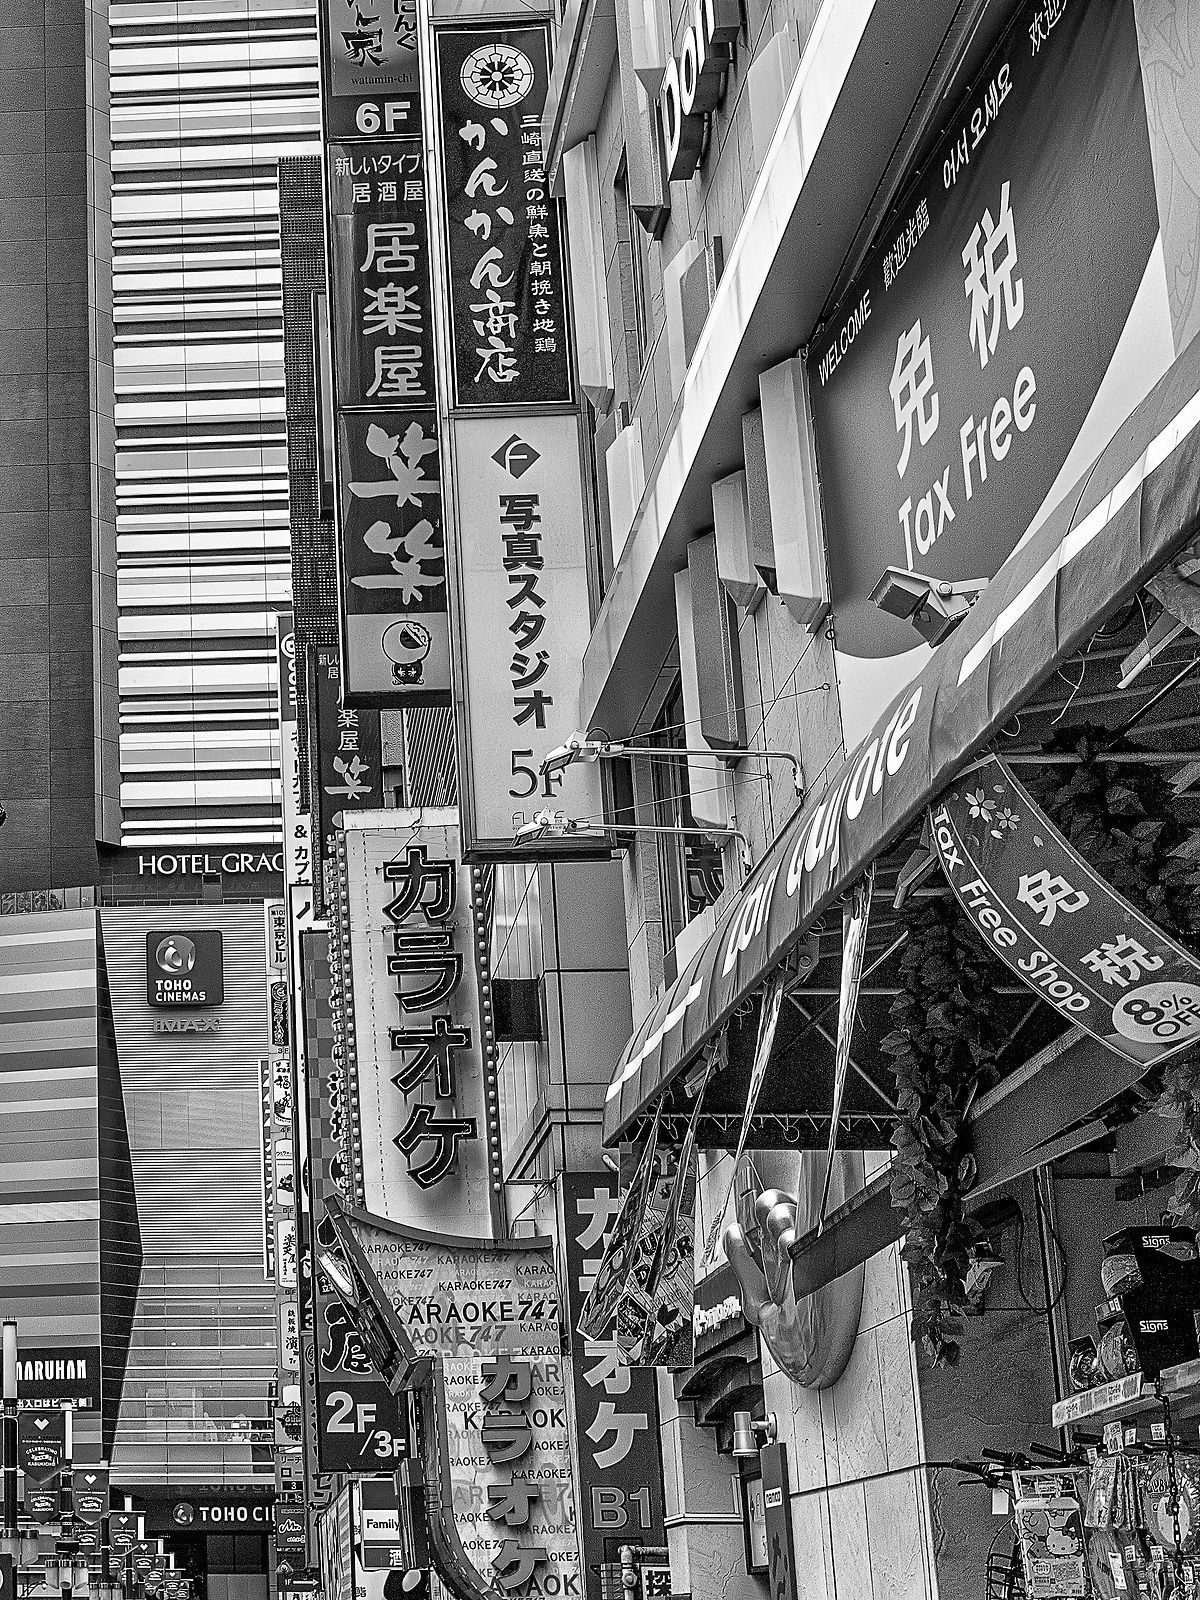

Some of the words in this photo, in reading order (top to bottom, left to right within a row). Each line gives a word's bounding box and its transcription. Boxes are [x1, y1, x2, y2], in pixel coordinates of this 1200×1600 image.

[351, 73, 413, 86] watamin-chi
[356, 101, 411, 133] 6F
[943, 128, 969, 188] 어서
[970, 63, 1013, 150] 오세요
[335, 153, 422, 176] 新しいタイプ
[352, 180, 424, 203] 居酒屋
[458, 117, 521, 383] かんかん商店
[520, 114, 558, 353] 三崎直送の鮮魚と朝挽き地鶏
[360, 222, 426, 397] 居楽屋
[889, 181, 1024, 479] 免税
[818, 289, 872, 387] WELCOME
[898, 464, 956, 572] Tax
[960, 366, 1037, 502] Free
[499, 493, 554, 730] 写真スタジオ
[336, 686, 360, 751] 楽屋
[508, 748, 566, 799] 5F
[138, 854, 217, 875] HOTEL
[933, 806, 965, 872] Tax
[959, 878, 1018, 948] Free
[1017, 950, 1091, 1012] Shop
[1016, 869, 1165, 988] 免税
[273, 916, 287, 964] 東京ビル
[155, 979, 192, 990] TOHO
[155, 991, 207, 1002] CINEMAS
[381, 844, 479, 1191] カラオケ
[437, 1253, 511, 1265] KARAOKE747
[1142, 1235, 1171, 1248] Signs
[438, 1279, 513, 1292] KARAOKE747
[1139, 1319, 1169, 1333] Signs
[325, 1390, 377, 1433] 2F
[358, 1429, 406, 1458] /3F
[479, 1355, 547, 1590] カラオケ
[199, 1505, 248, 1522] TOHO
[366, 1518, 400, 1531] Family
[589, 1485, 651, 1530] B1
